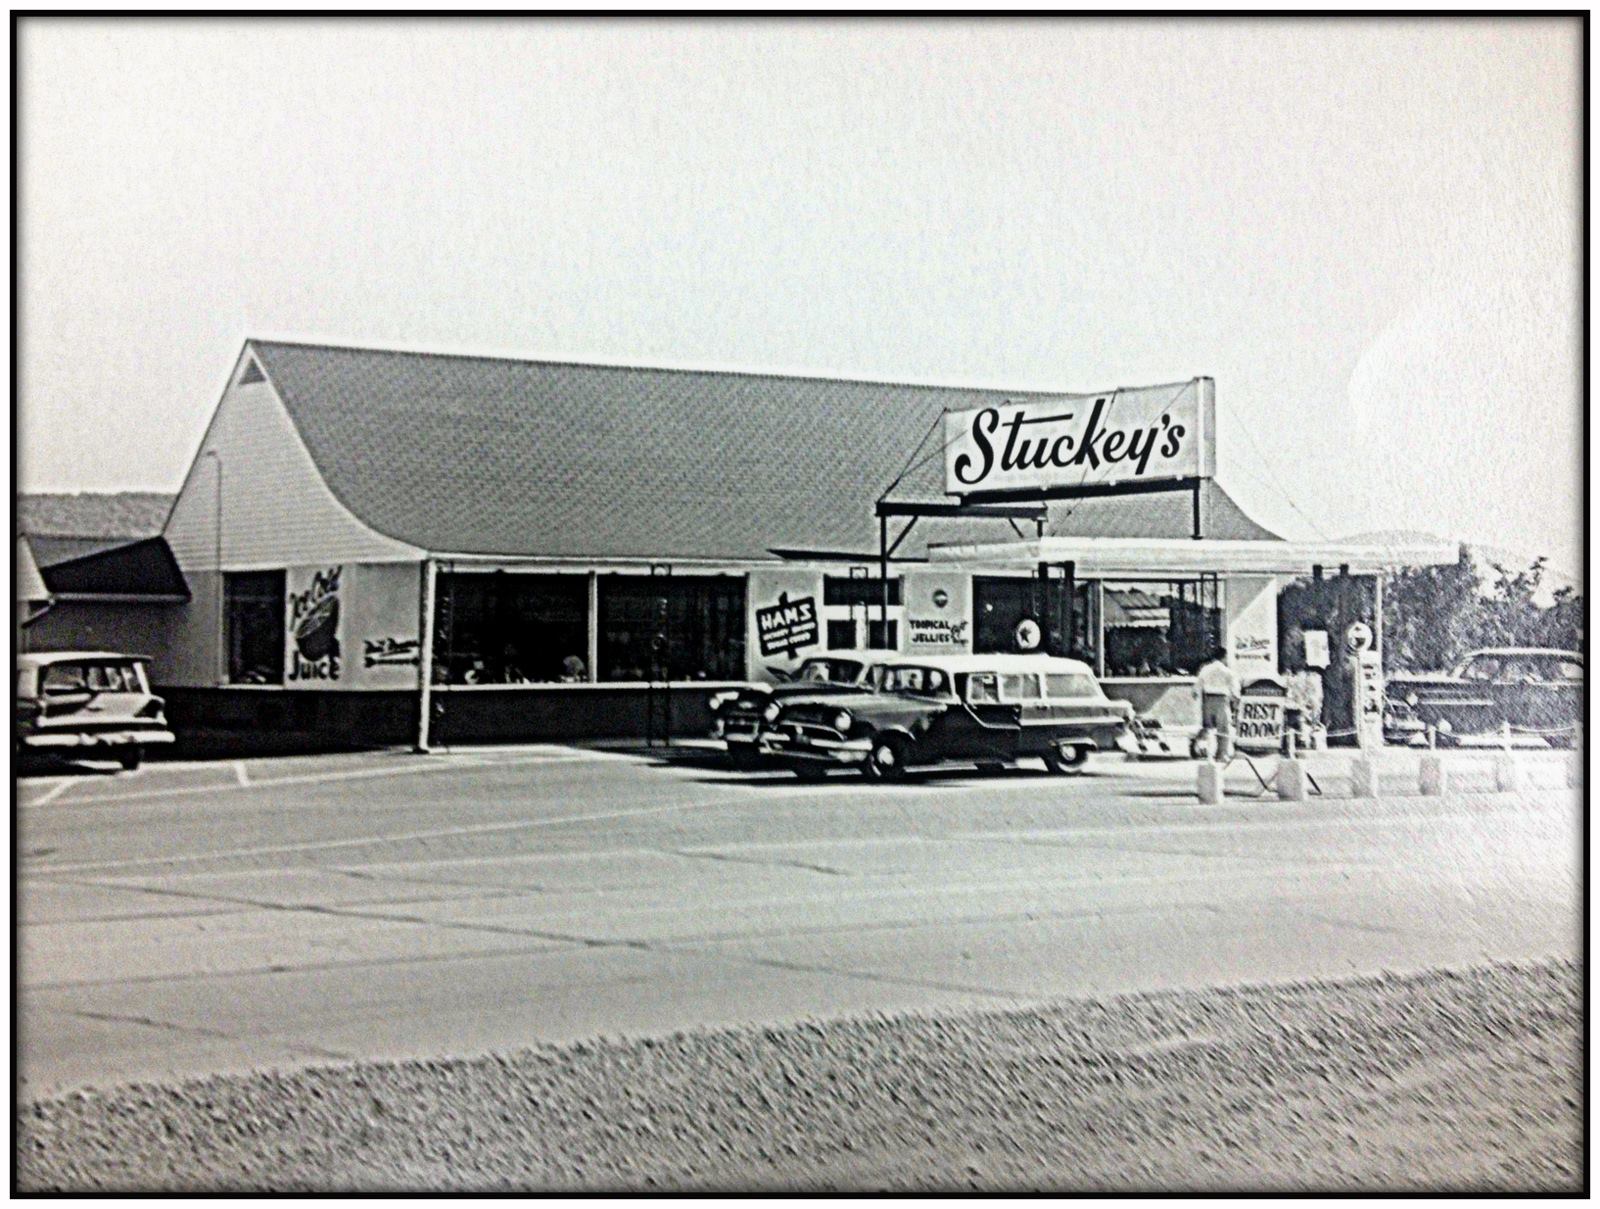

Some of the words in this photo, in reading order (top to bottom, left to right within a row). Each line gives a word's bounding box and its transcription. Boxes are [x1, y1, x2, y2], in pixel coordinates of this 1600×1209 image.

[955, 398, 1185, 484] Stuckey's
[761, 603, 812, 630] HAMS
[909, 619, 951, 630] TROPICAL
[911, 633, 950, 643] JELLIES
[1243, 703, 1280, 720] REST
